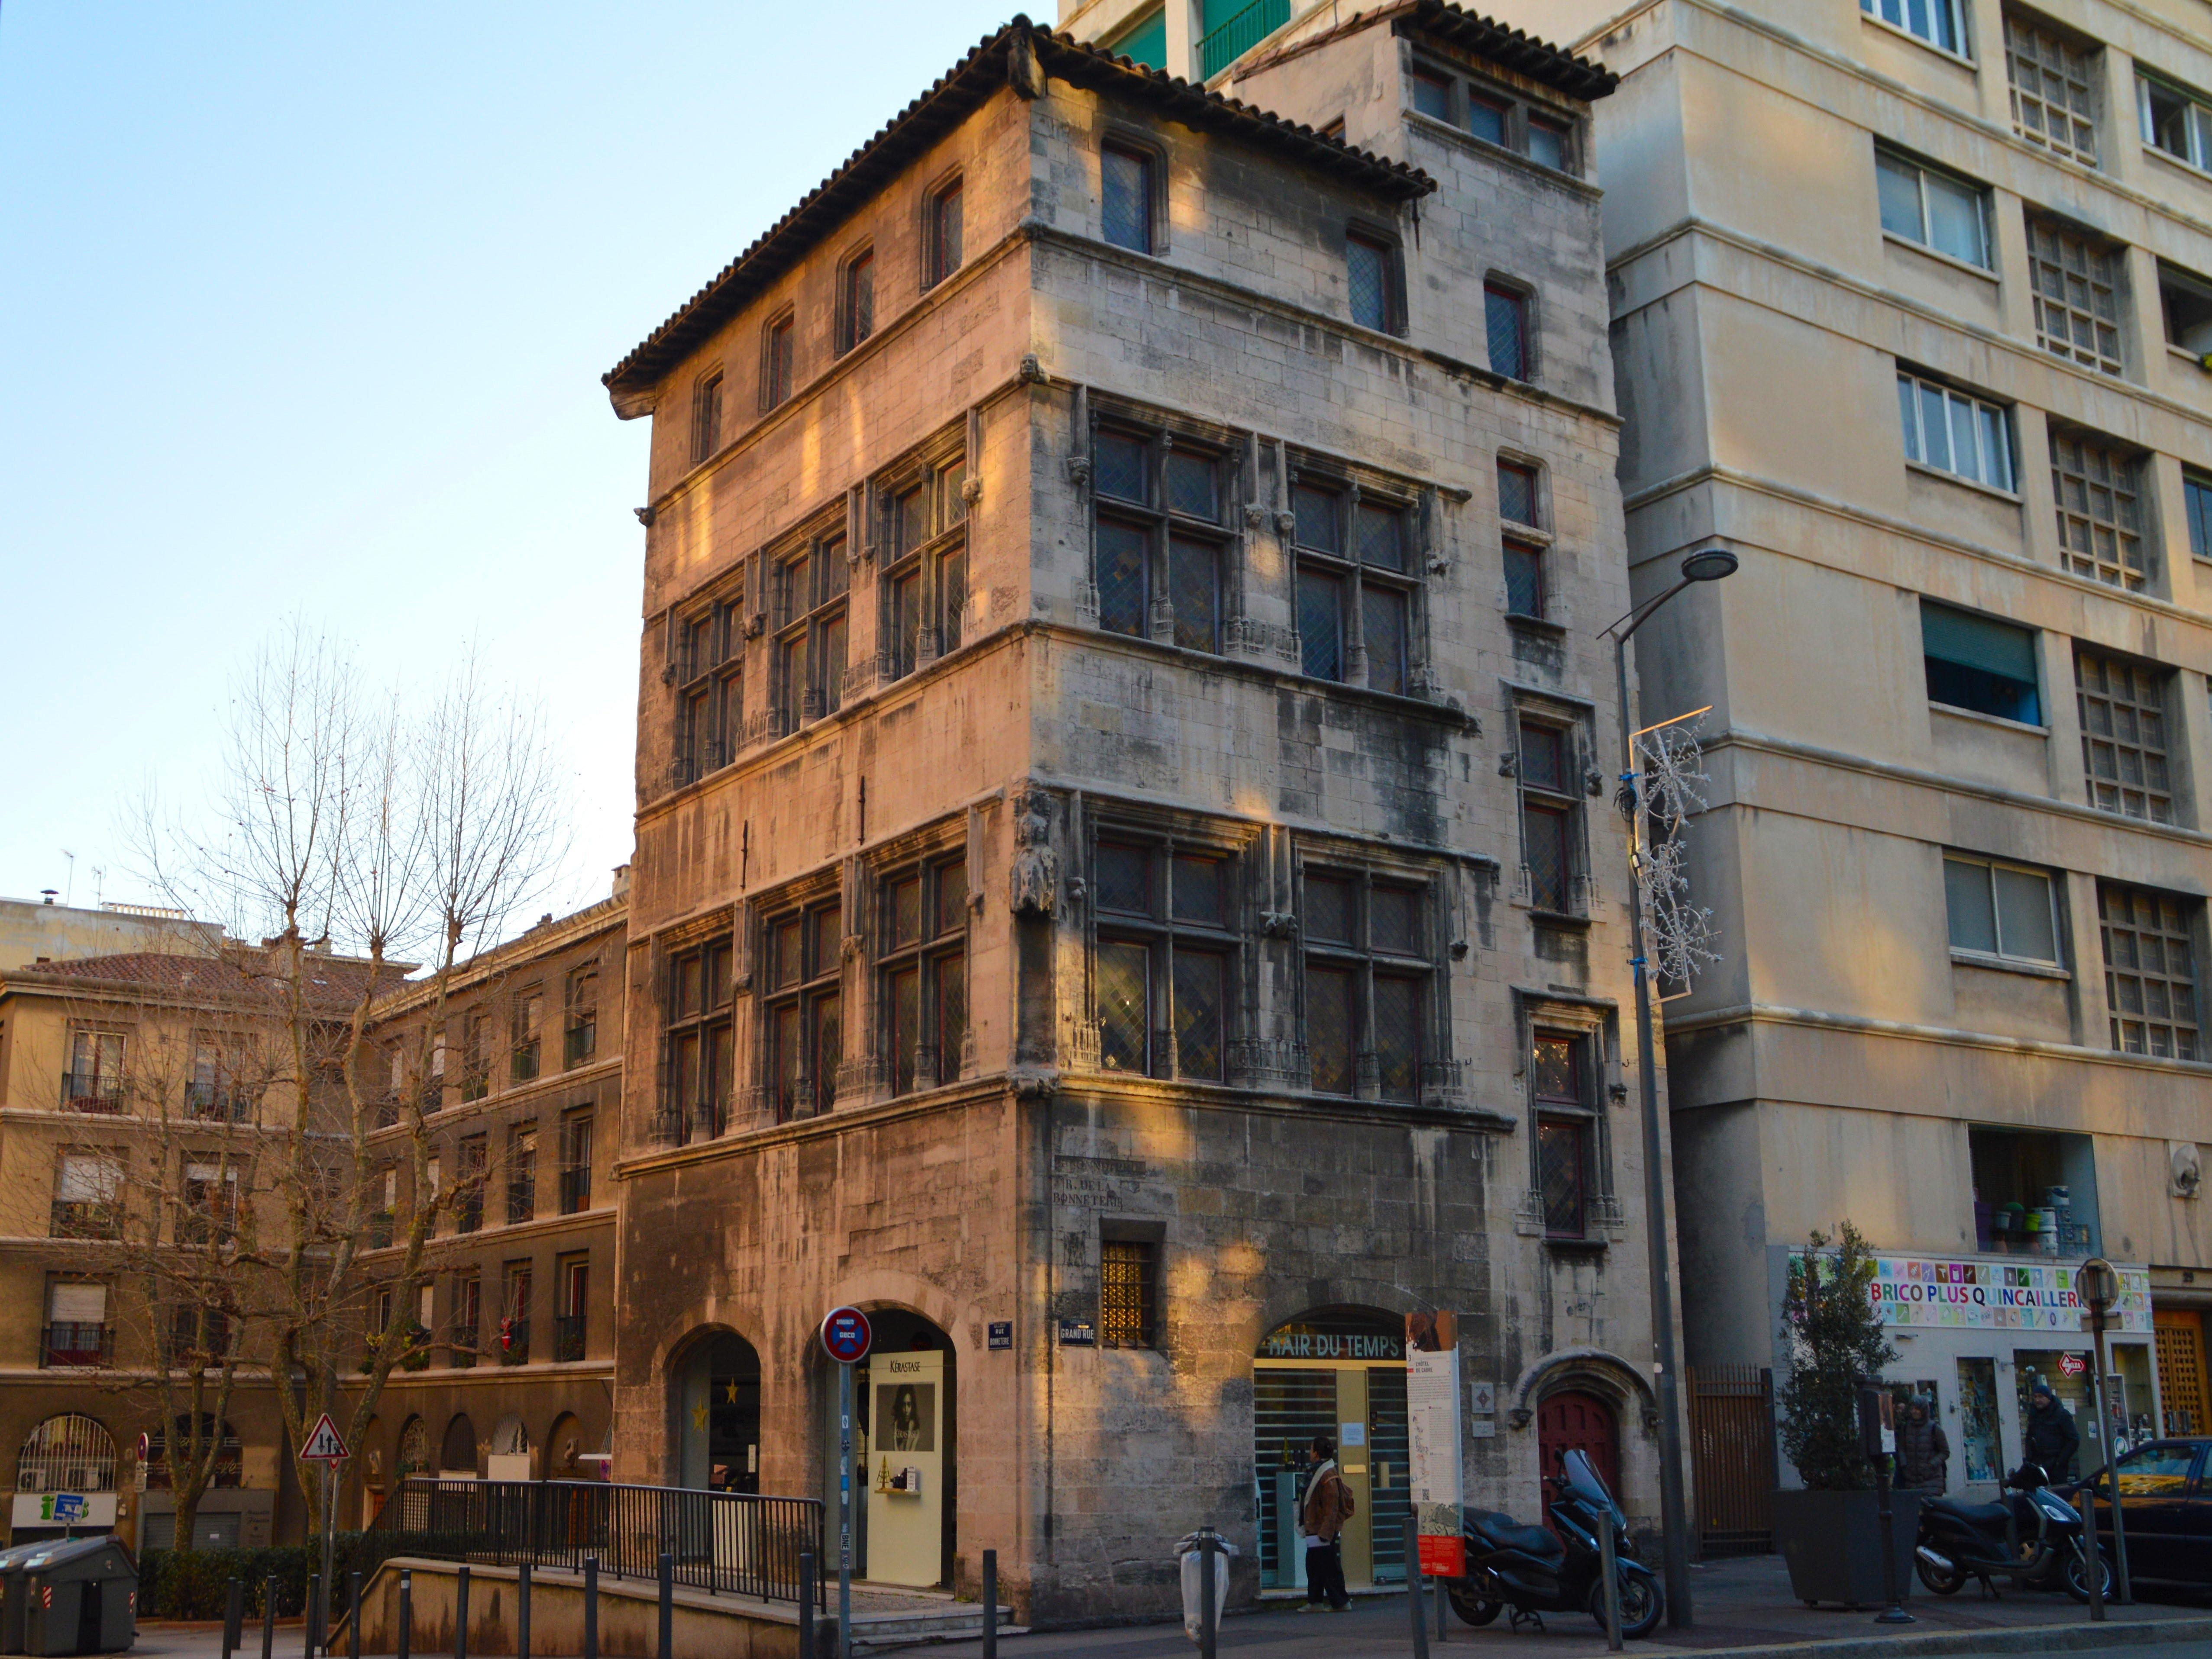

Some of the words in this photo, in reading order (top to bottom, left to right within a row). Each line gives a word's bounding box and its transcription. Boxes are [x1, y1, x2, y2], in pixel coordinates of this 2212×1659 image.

[1871, 1282, 1923, 1302] BRICO
[1927, 1286, 1969, 1303] PLUS
[1972, 1288, 2082, 1307] QUINCAILLER
[1061, 1328, 1081, 1339] GRAND
[1083, 1329, 1094, 1339] RUE
[1270, 1335, 1310, 1356] HAIR
[1316, 1334, 1340, 1356] DU
[1347, 1335, 1400, 1357] TEMPS
[890, 1360, 920, 1373] KÉRASTASE
